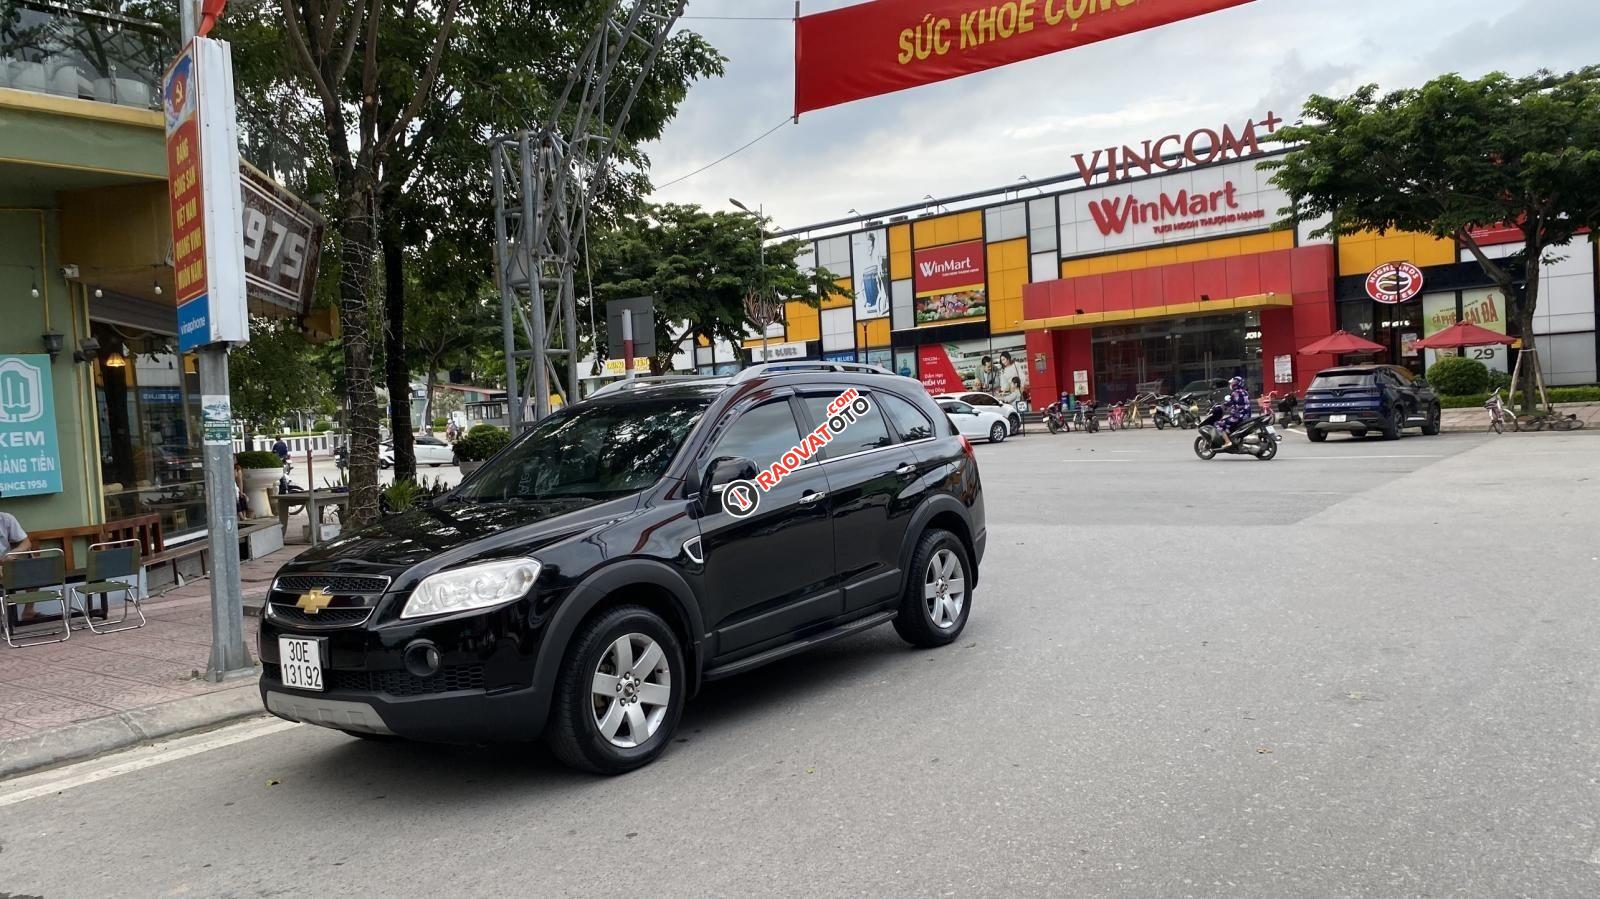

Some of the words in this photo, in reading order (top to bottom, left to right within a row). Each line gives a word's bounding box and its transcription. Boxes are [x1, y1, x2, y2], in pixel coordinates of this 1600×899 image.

[898, 14, 950, 64] SỨC
[1088, 181, 1239, 236] WinMart
[920, 256, 971, 277] WinMart
[1369, 264, 1419, 283] HIGHLNDS
[1376, 289, 1414, 300] COFEE
[181, 316, 206, 335] vinaphone
[1474, 348, 1494, 360] 29
[288, 640, 310, 663] 30E
[284, 663, 321, 687] 131.92
